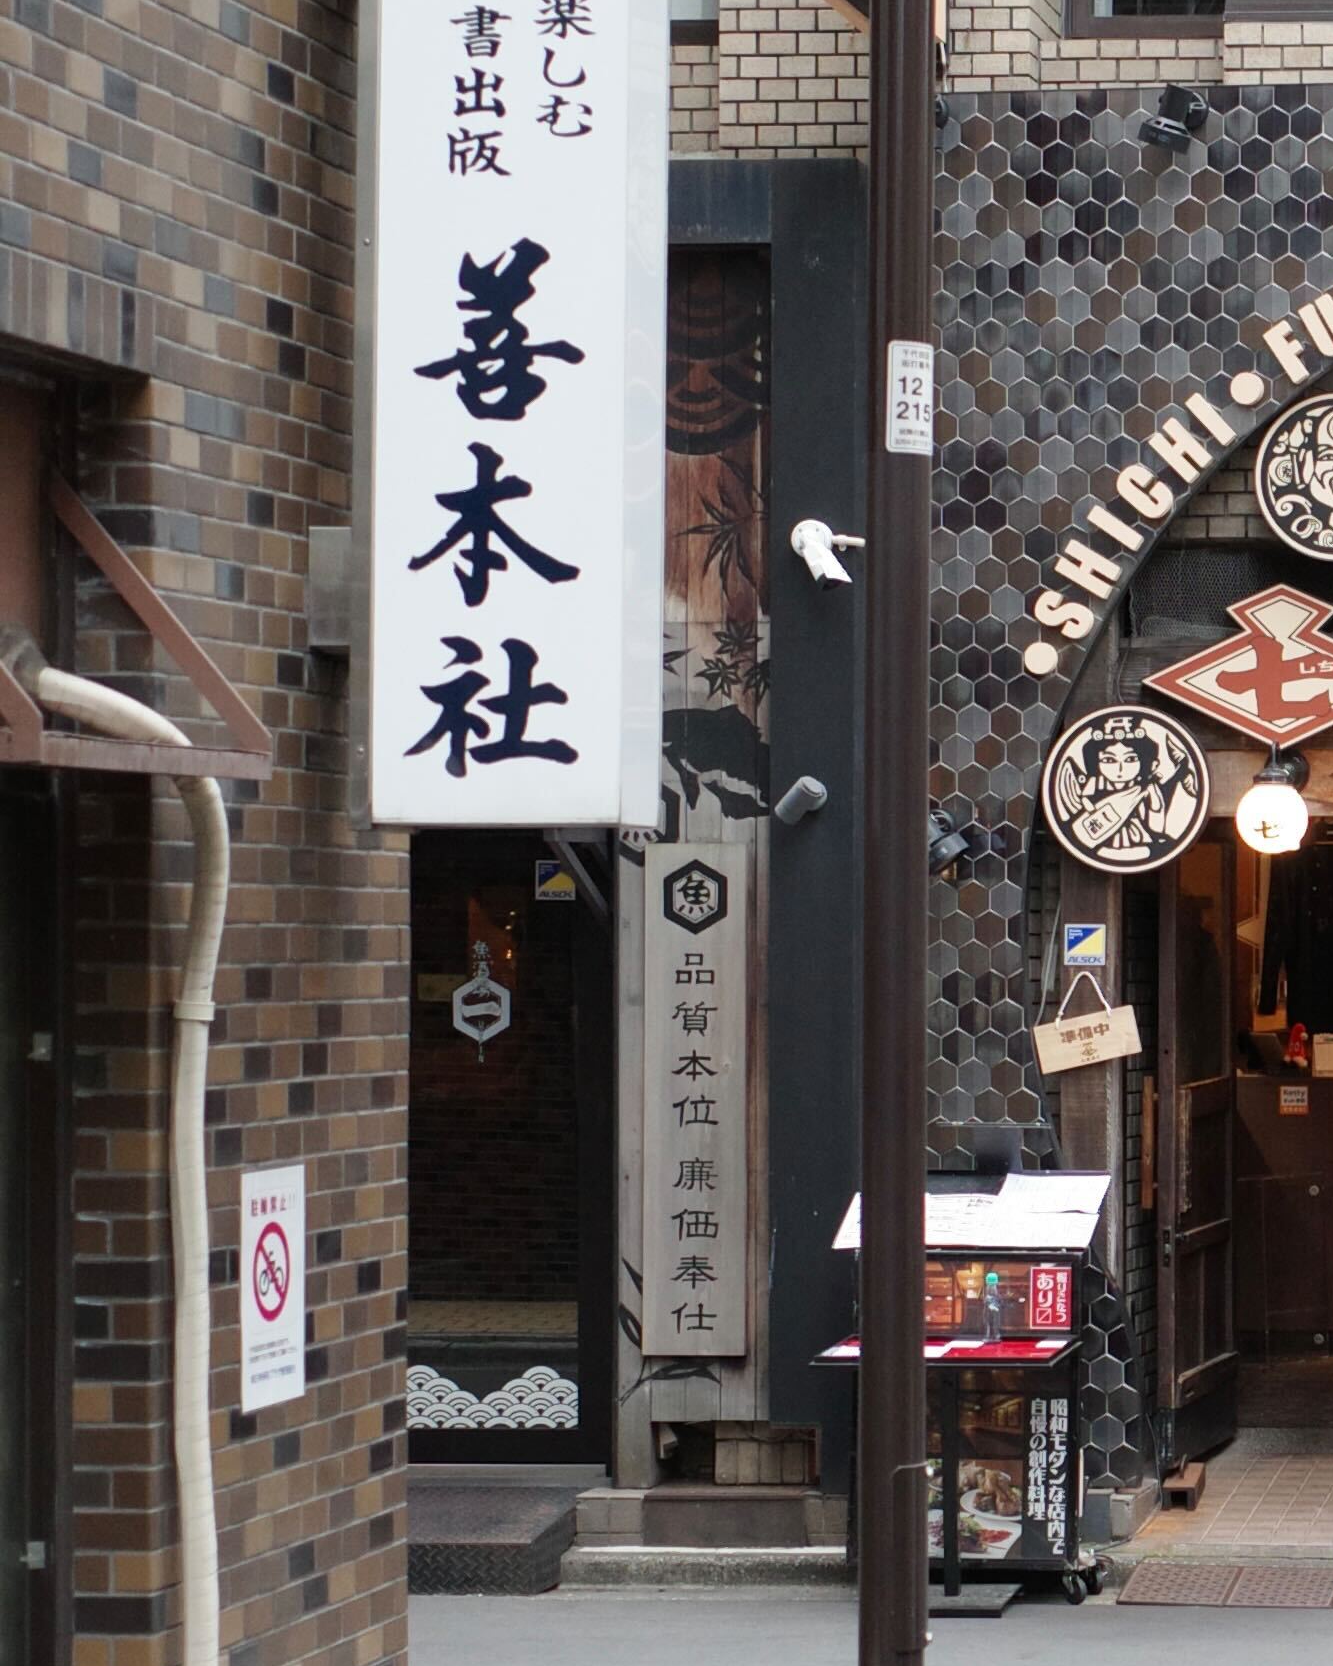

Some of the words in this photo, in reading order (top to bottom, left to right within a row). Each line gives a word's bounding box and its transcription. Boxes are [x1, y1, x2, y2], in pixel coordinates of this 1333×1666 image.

[896, 401, 931, 423] 215
[898, 375, 923, 396] 12
[402, 237, 587, 779] 善本社
[1034, 391, 1238, 641] SHICHI
[677, 873, 716, 915] 魚
[1067, 956, 1103, 965] ALSOK
[670, 951, 720, 1129] 品質本位
[1059, 1022, 1111, 1045] 準備中
[670, 1155, 720, 1336] 廉価奉仕
[1027, 1397, 1048, 1521] 自慢の創作料理
[1047, 1397, 1069, 1556] 昭和モダンな店内で
